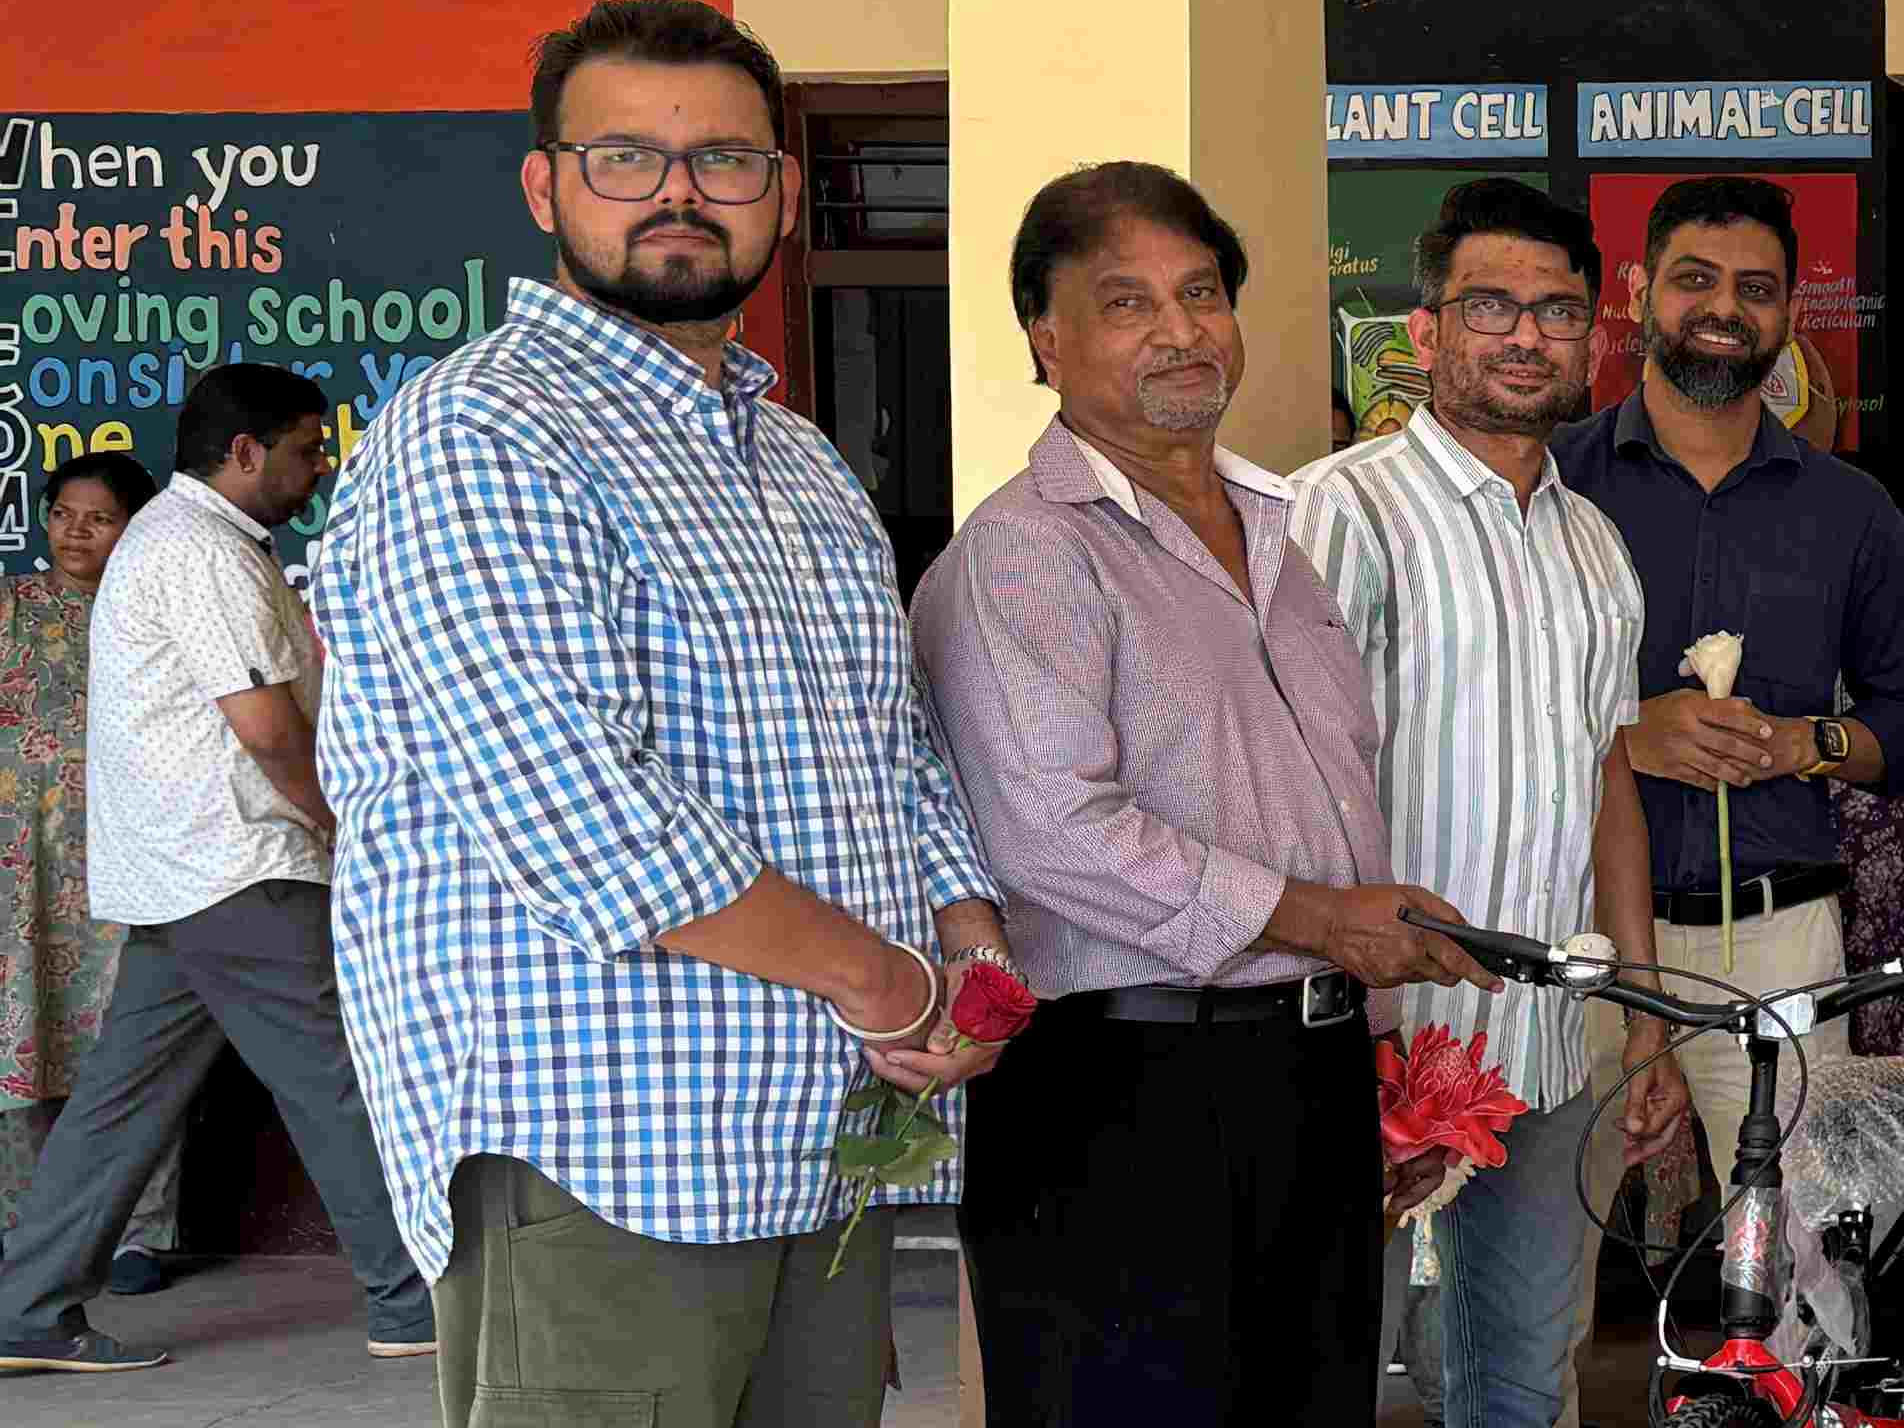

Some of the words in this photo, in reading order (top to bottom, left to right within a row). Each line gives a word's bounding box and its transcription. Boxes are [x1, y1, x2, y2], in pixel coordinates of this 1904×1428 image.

[1326, 91, 1442, 140] LANT
[1452, 91, 1543, 140] CELL
[1590, 88, 1776, 142] ANIMAL
[1783, 87, 1869, 135] CELL
[185, 143, 320, 214] you
[0, 202, 149, 272] nter
[160, 204, 283, 272] this
[0, 276, 220, 370] oving
[248, 259, 486, 346] school
